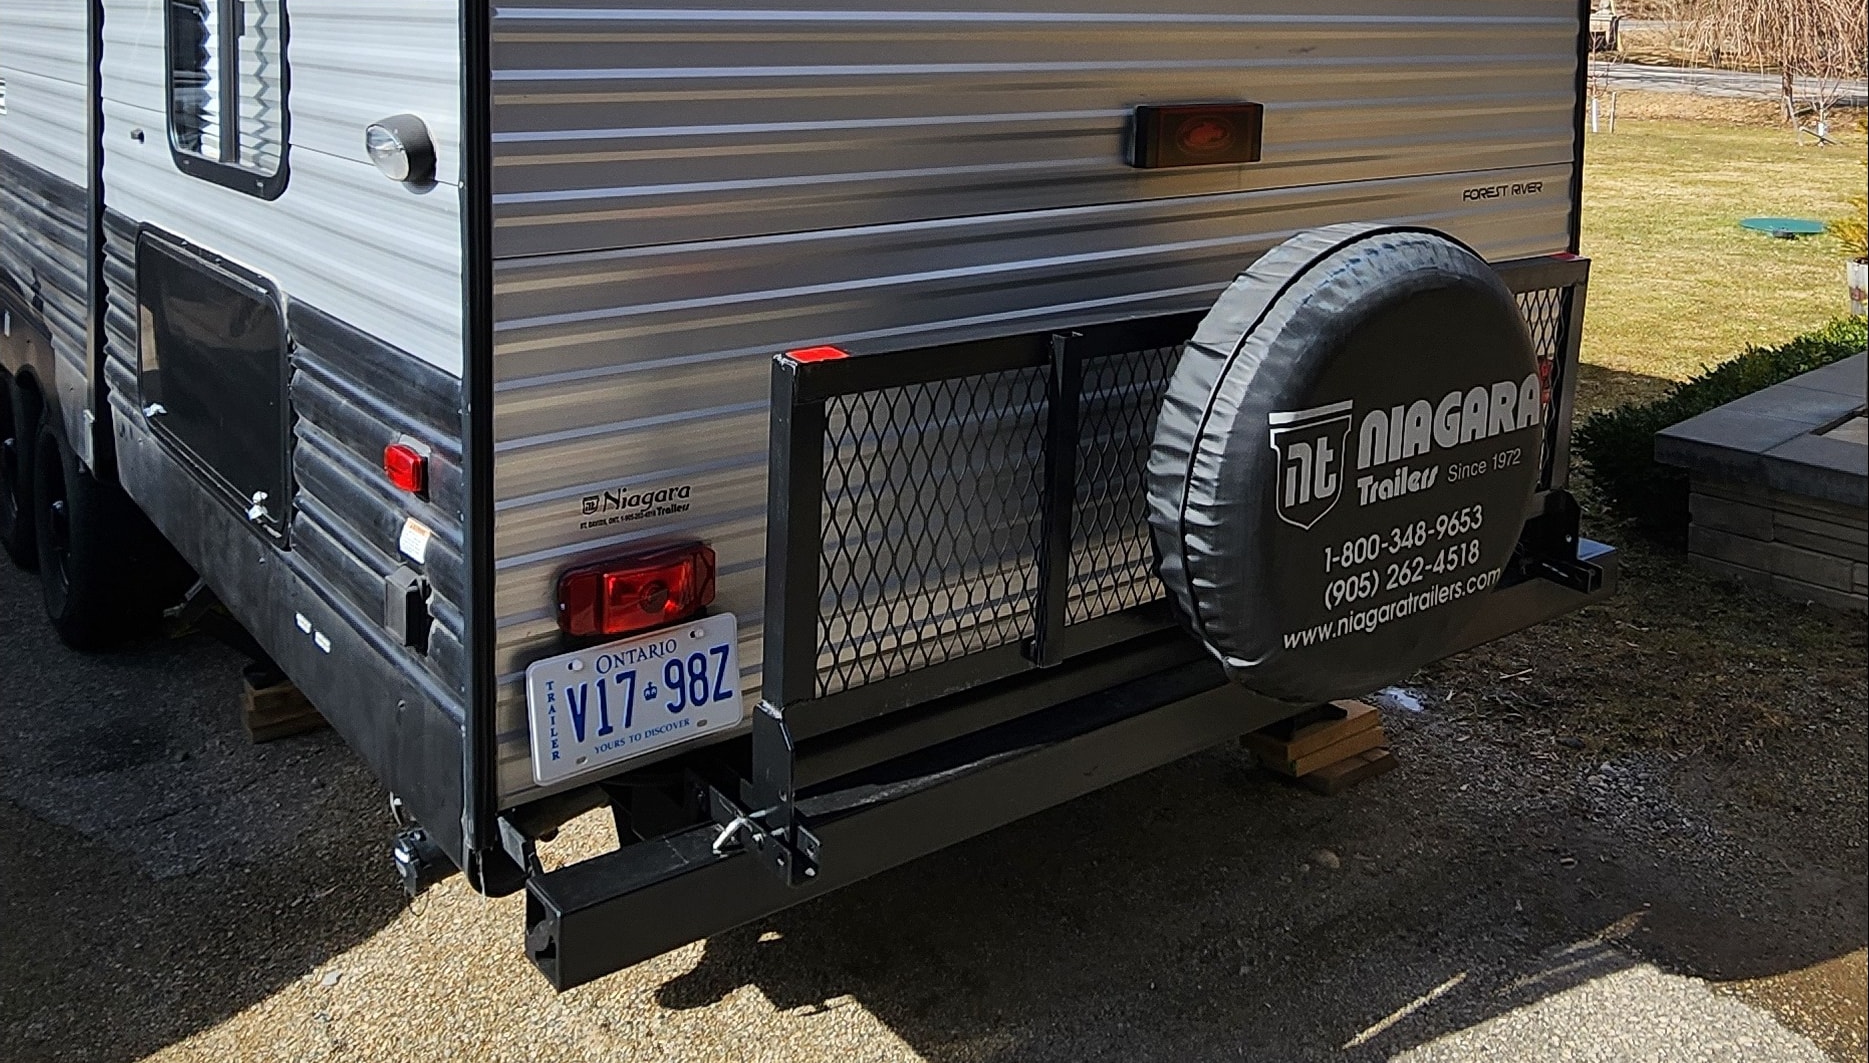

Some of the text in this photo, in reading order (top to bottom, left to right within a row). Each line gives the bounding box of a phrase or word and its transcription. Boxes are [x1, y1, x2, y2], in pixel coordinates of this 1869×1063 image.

[1463, 182, 1543, 201] FOREST RIVER
[1357, 373, 1541, 470] NIAGARA
[603, 486, 690, 512] Niagara
[1357, 447, 1521, 506] Trailers Since 1972
[657, 503, 689, 516] Trailers
[1324, 504, 1483, 573] 1-800-348-9653
[1324, 539, 1480, 610] (905) 262-4518
[1283, 567, 1501, 649] www.niagaratrailers.com
[596, 639, 677, 674] ONTARIO
[545, 680, 560, 761] TRAILER
[566, 644, 733, 743] V17 98Z
[594, 718, 690, 754] YOURS TO DISCOVER
